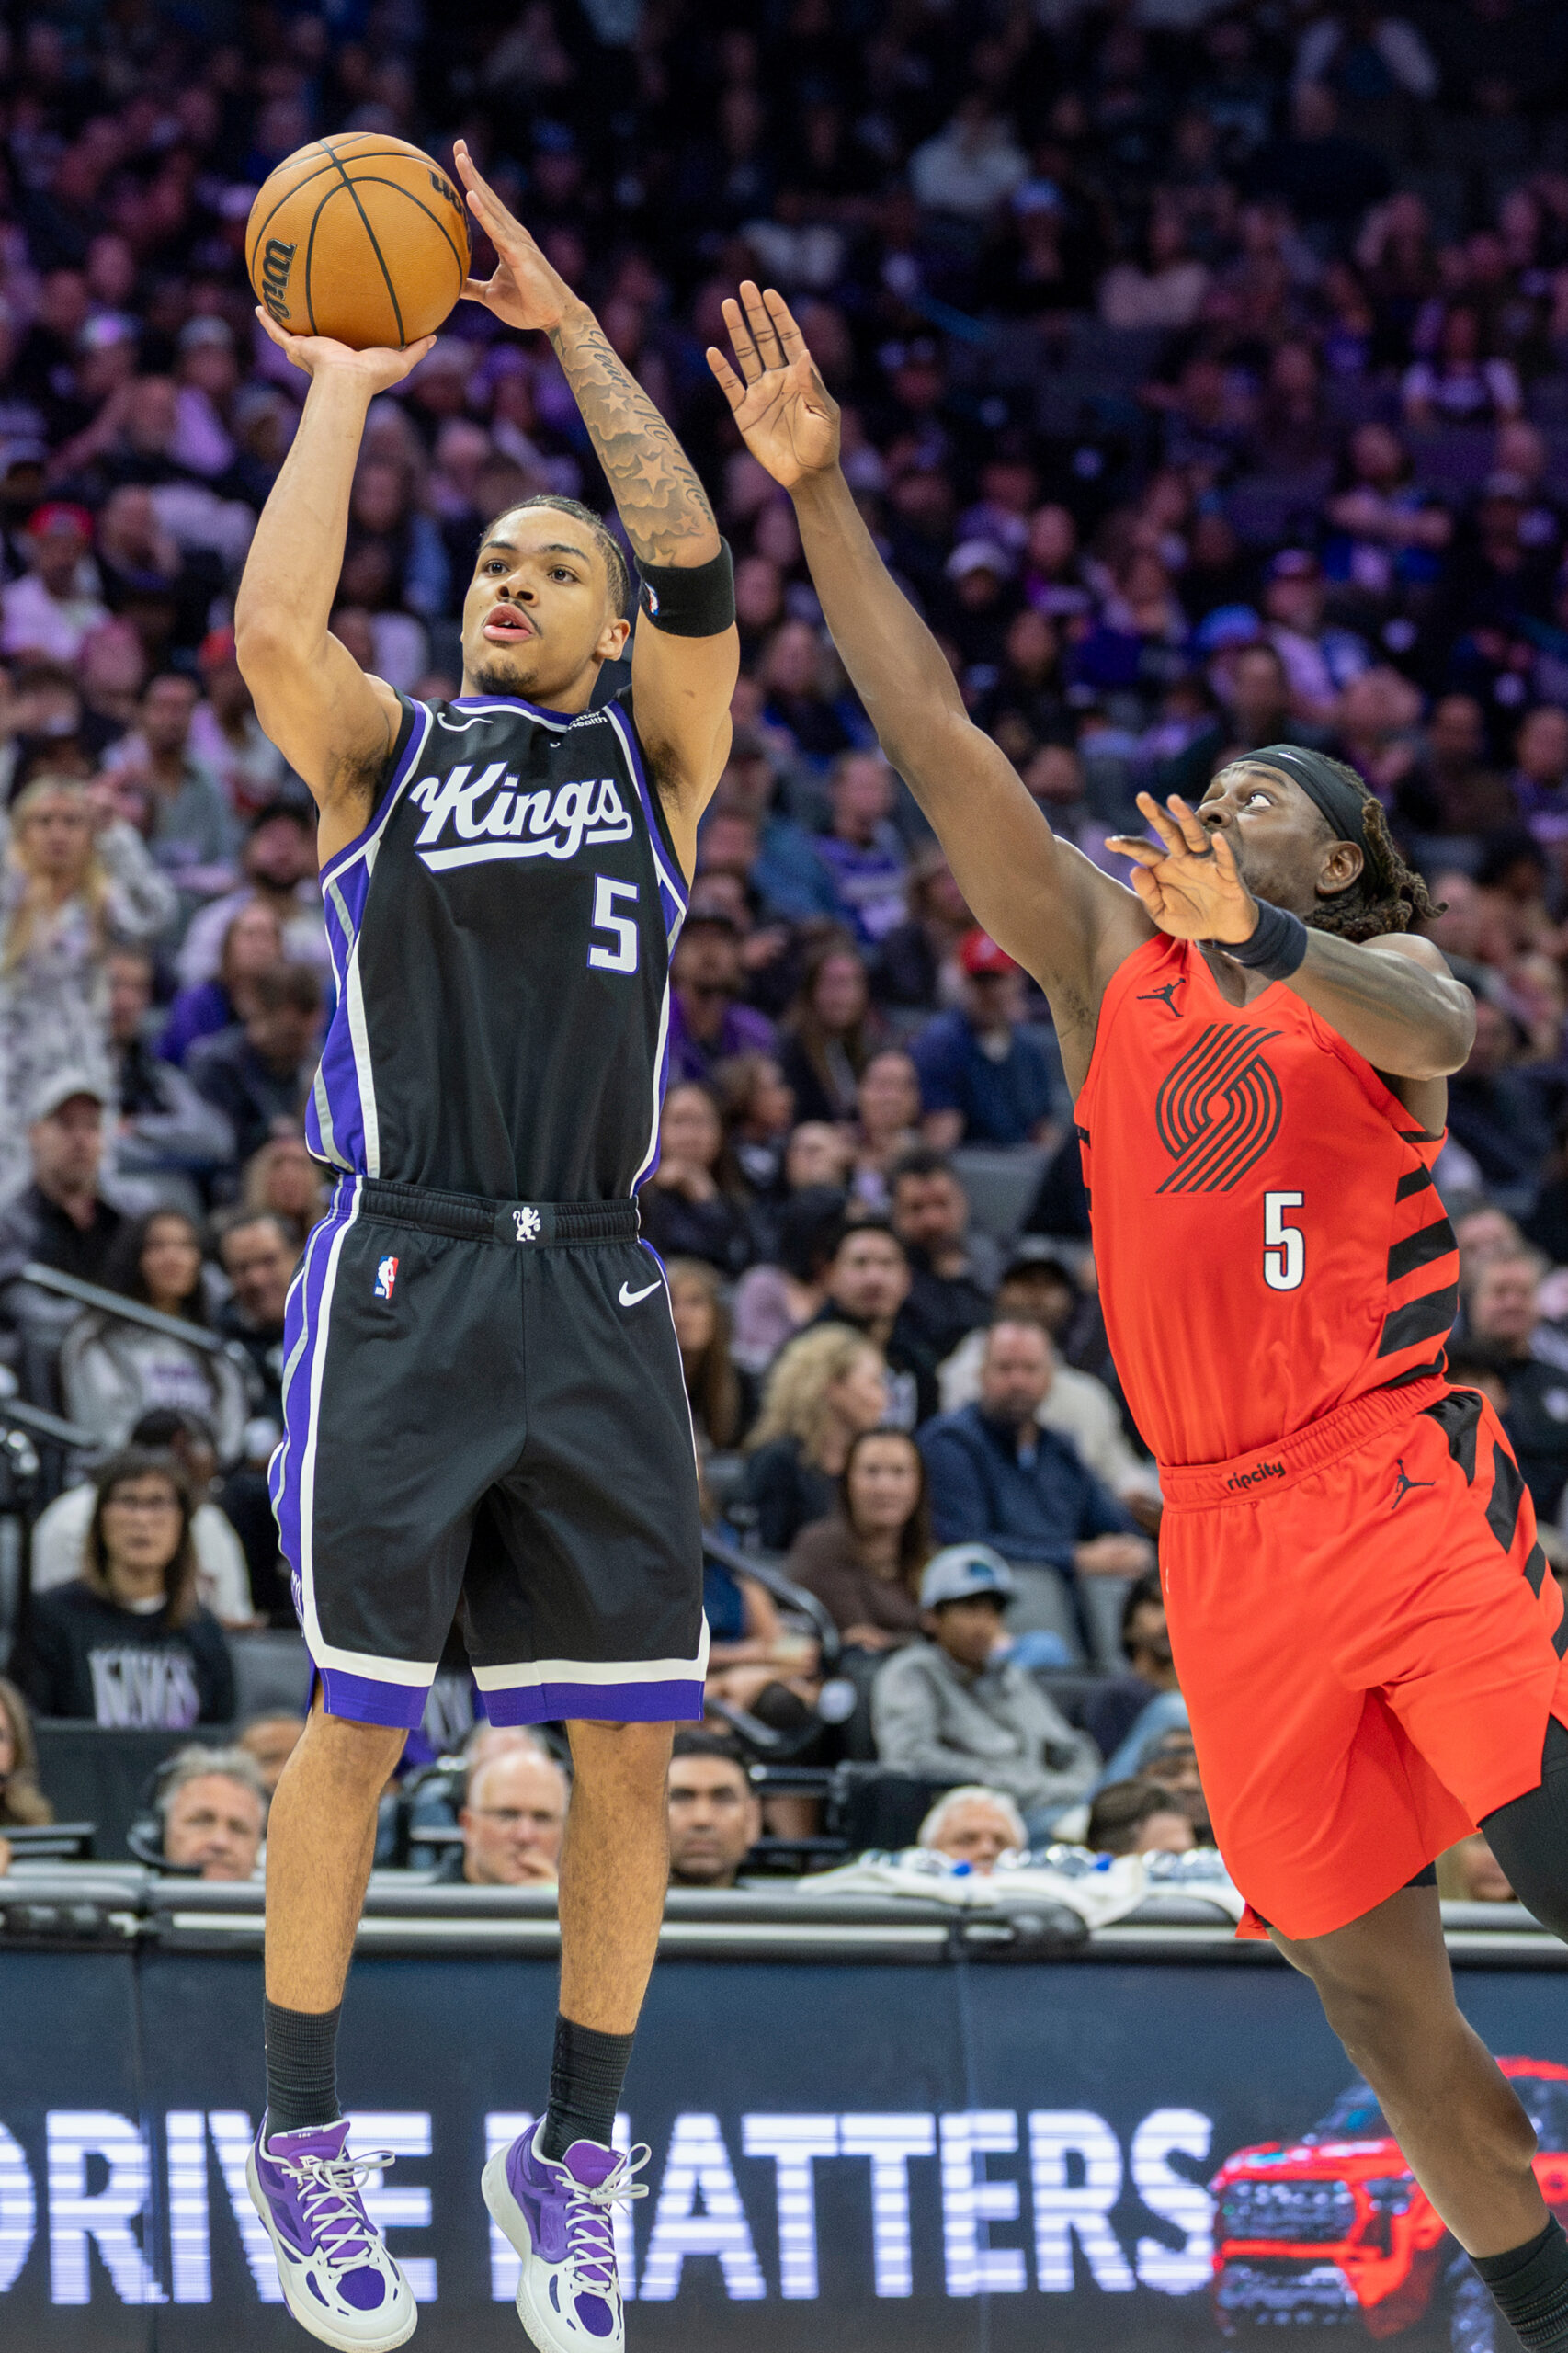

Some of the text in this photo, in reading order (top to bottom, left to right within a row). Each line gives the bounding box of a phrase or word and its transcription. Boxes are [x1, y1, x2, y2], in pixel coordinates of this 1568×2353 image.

[408, 761, 633, 872] Kings
[587, 873, 640, 976] 5
[1263, 1190, 1306, 1292] 5
[1227, 1461, 1286, 1490] ripcity
